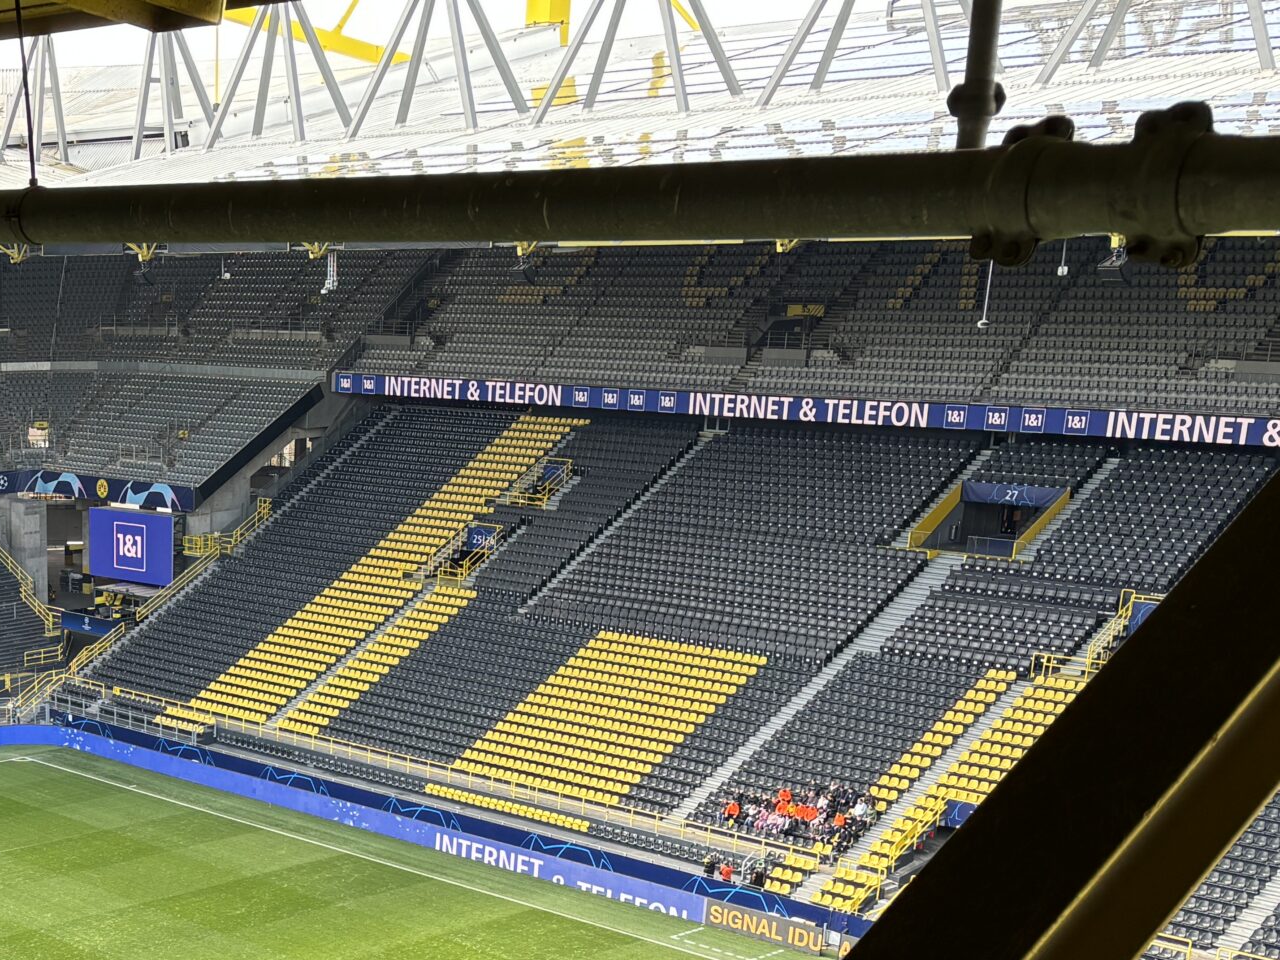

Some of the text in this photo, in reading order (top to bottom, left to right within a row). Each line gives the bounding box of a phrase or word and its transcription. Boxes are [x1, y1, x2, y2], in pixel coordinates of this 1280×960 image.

[384, 376, 463, 400] INTERNET
[466, 380, 480, 401] &
[485, 381, 562, 407] TELEFON
[688, 392, 794, 420] INTERNET
[799, 397, 817, 422] &
[824, 399, 930, 428] TELEFON
[947, 410, 965, 423] 1&1
[988, 412, 1006, 425] 1&1
[1024, 413, 1042, 427] 1&1
[1067, 415, 1086, 429] 1&1
[1105, 411, 1256, 445] INTERNET
[1262, 419, 1280, 447] &
[1004, 490, 1019, 500] 27
[117, 533, 142, 559] 1&1
[434, 832, 544, 878] INTERNET
[709, 905, 783, 941] SIGNAL
